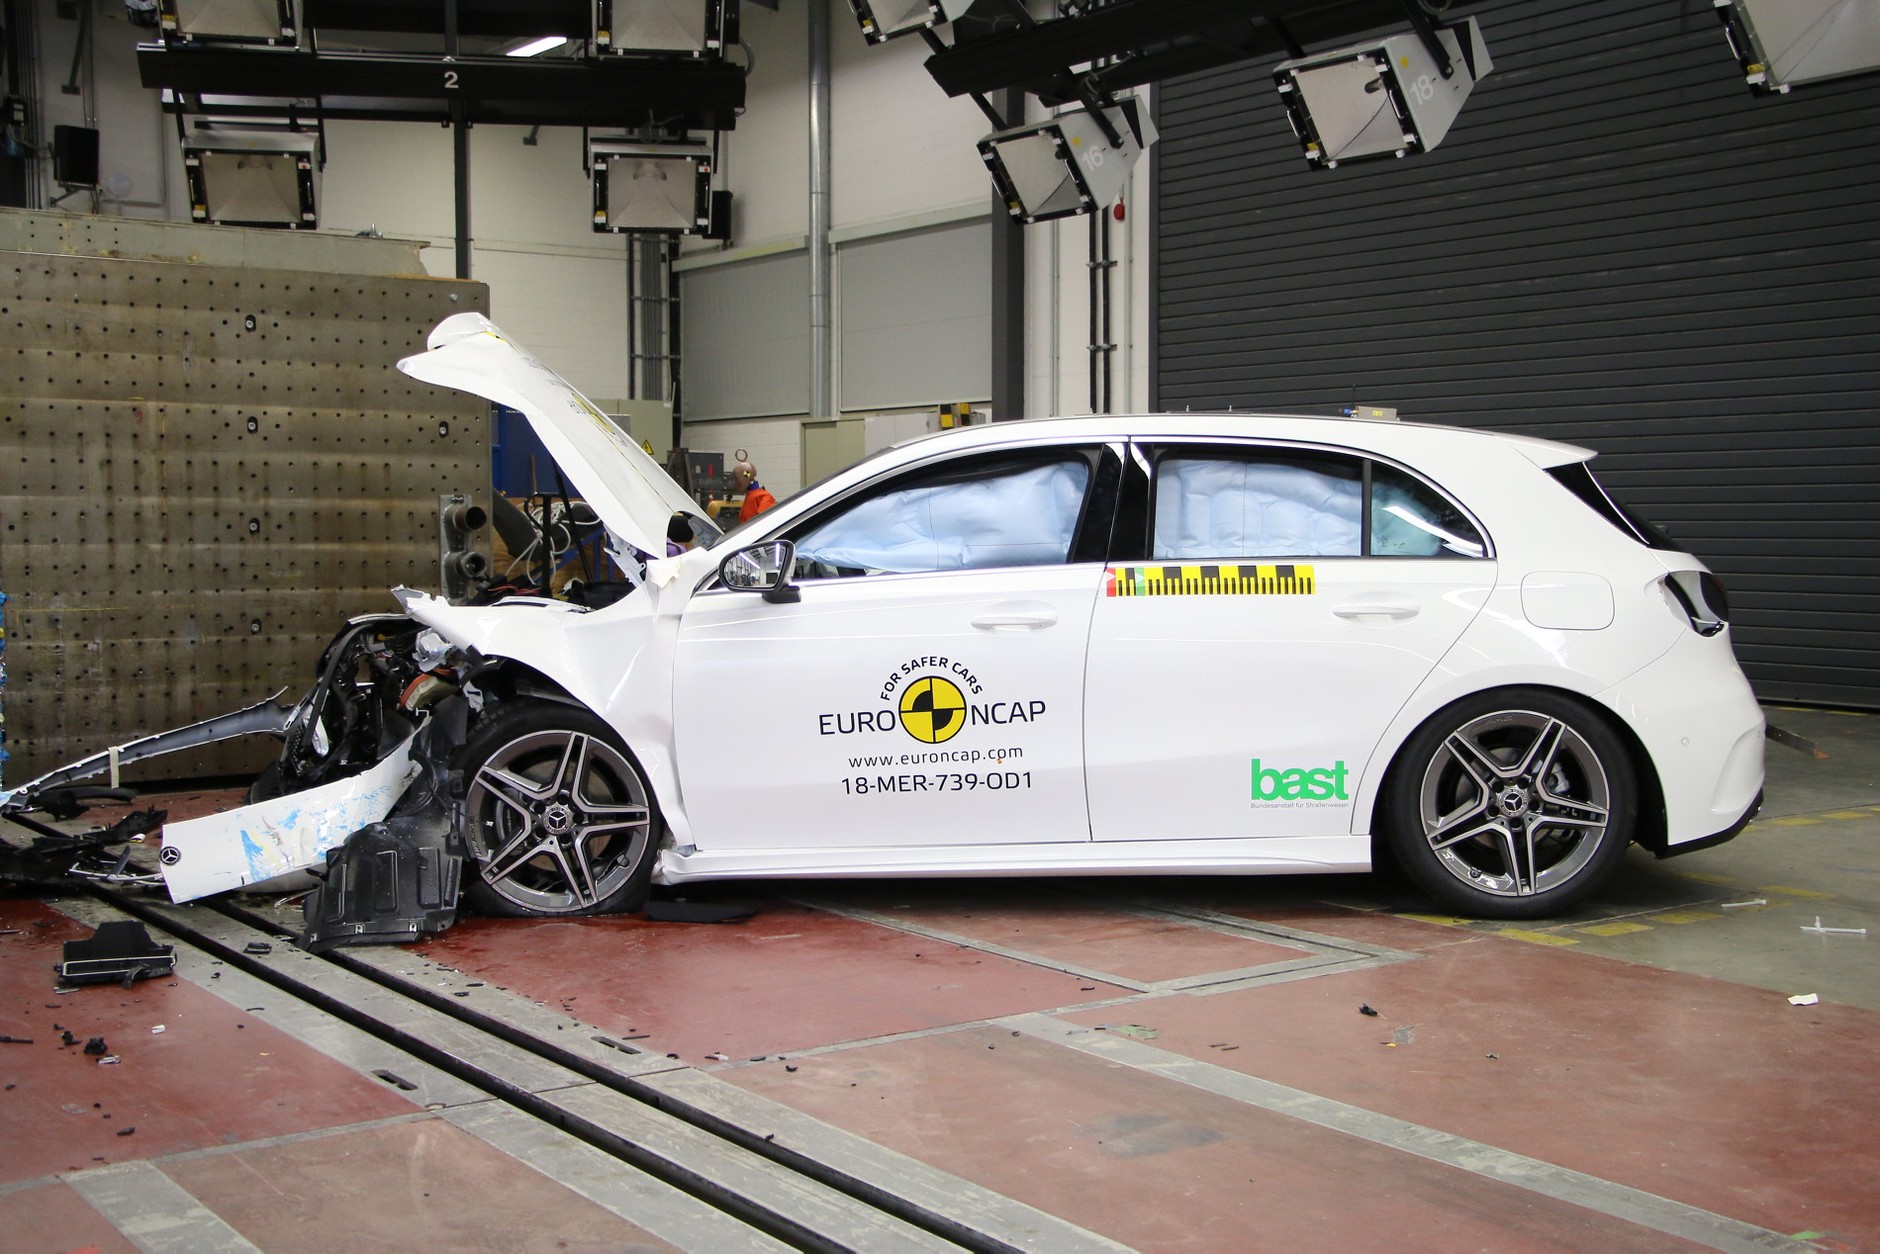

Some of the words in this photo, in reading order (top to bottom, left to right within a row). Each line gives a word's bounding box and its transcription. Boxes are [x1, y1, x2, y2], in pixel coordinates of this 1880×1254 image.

[444, 71, 459, 88] 2
[1410, 75, 1434, 105] 18
[1082, 146, 1104, 171] 16
[880, 672, 902, 701] FOR
[901, 656, 949, 675] SAFER
[951, 662, 983, 695] CARS
[818, 709, 896, 735] EURO
[971, 700, 1046, 726] NCAP
[848, 746, 1023, 768] www.euroncap.com
[841, 771, 1032, 795] 18-MER-739-OD1
[1251, 758, 1349, 801] bast
